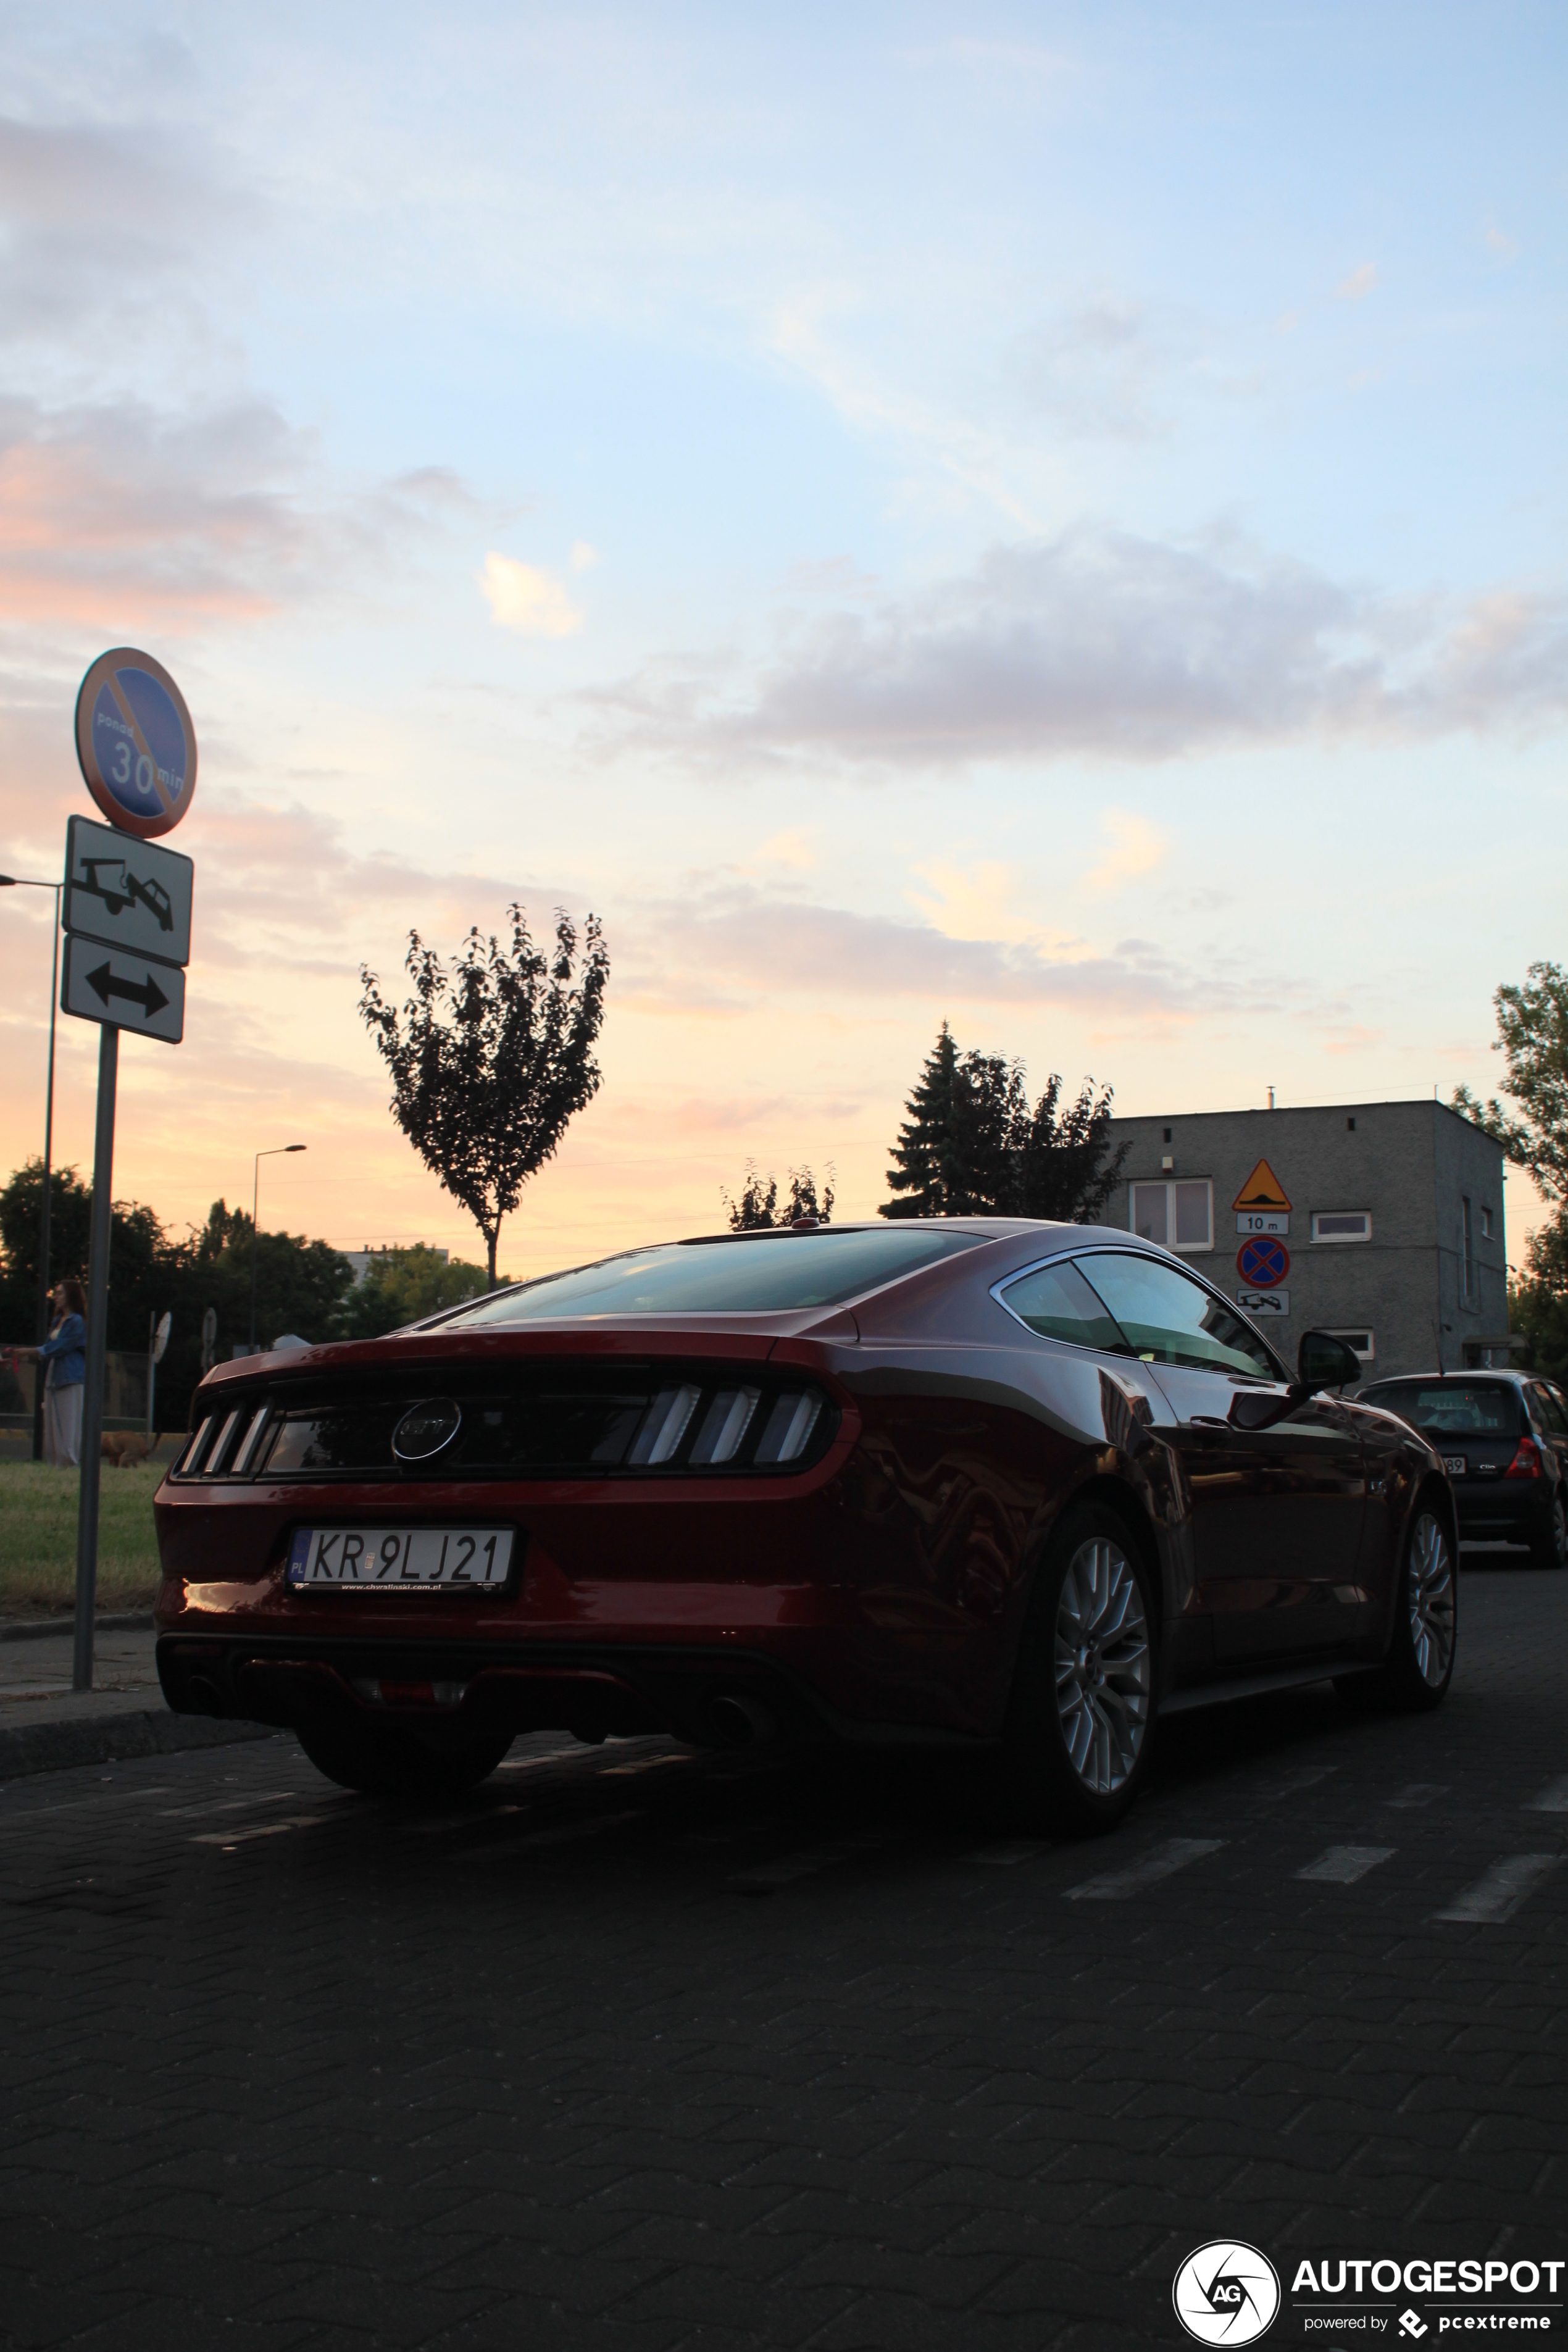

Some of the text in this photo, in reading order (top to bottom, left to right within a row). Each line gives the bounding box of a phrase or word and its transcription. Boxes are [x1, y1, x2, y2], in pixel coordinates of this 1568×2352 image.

[98, 712, 134, 738] ponad
[112, 742, 184, 794] 30 min
[1248, 1217, 1263, 1229] 10
[400, 1419, 454, 1435] GT
[312, 1534, 498, 1580] KR 9LJ21
[291, 1562, 304, 1574] PL
